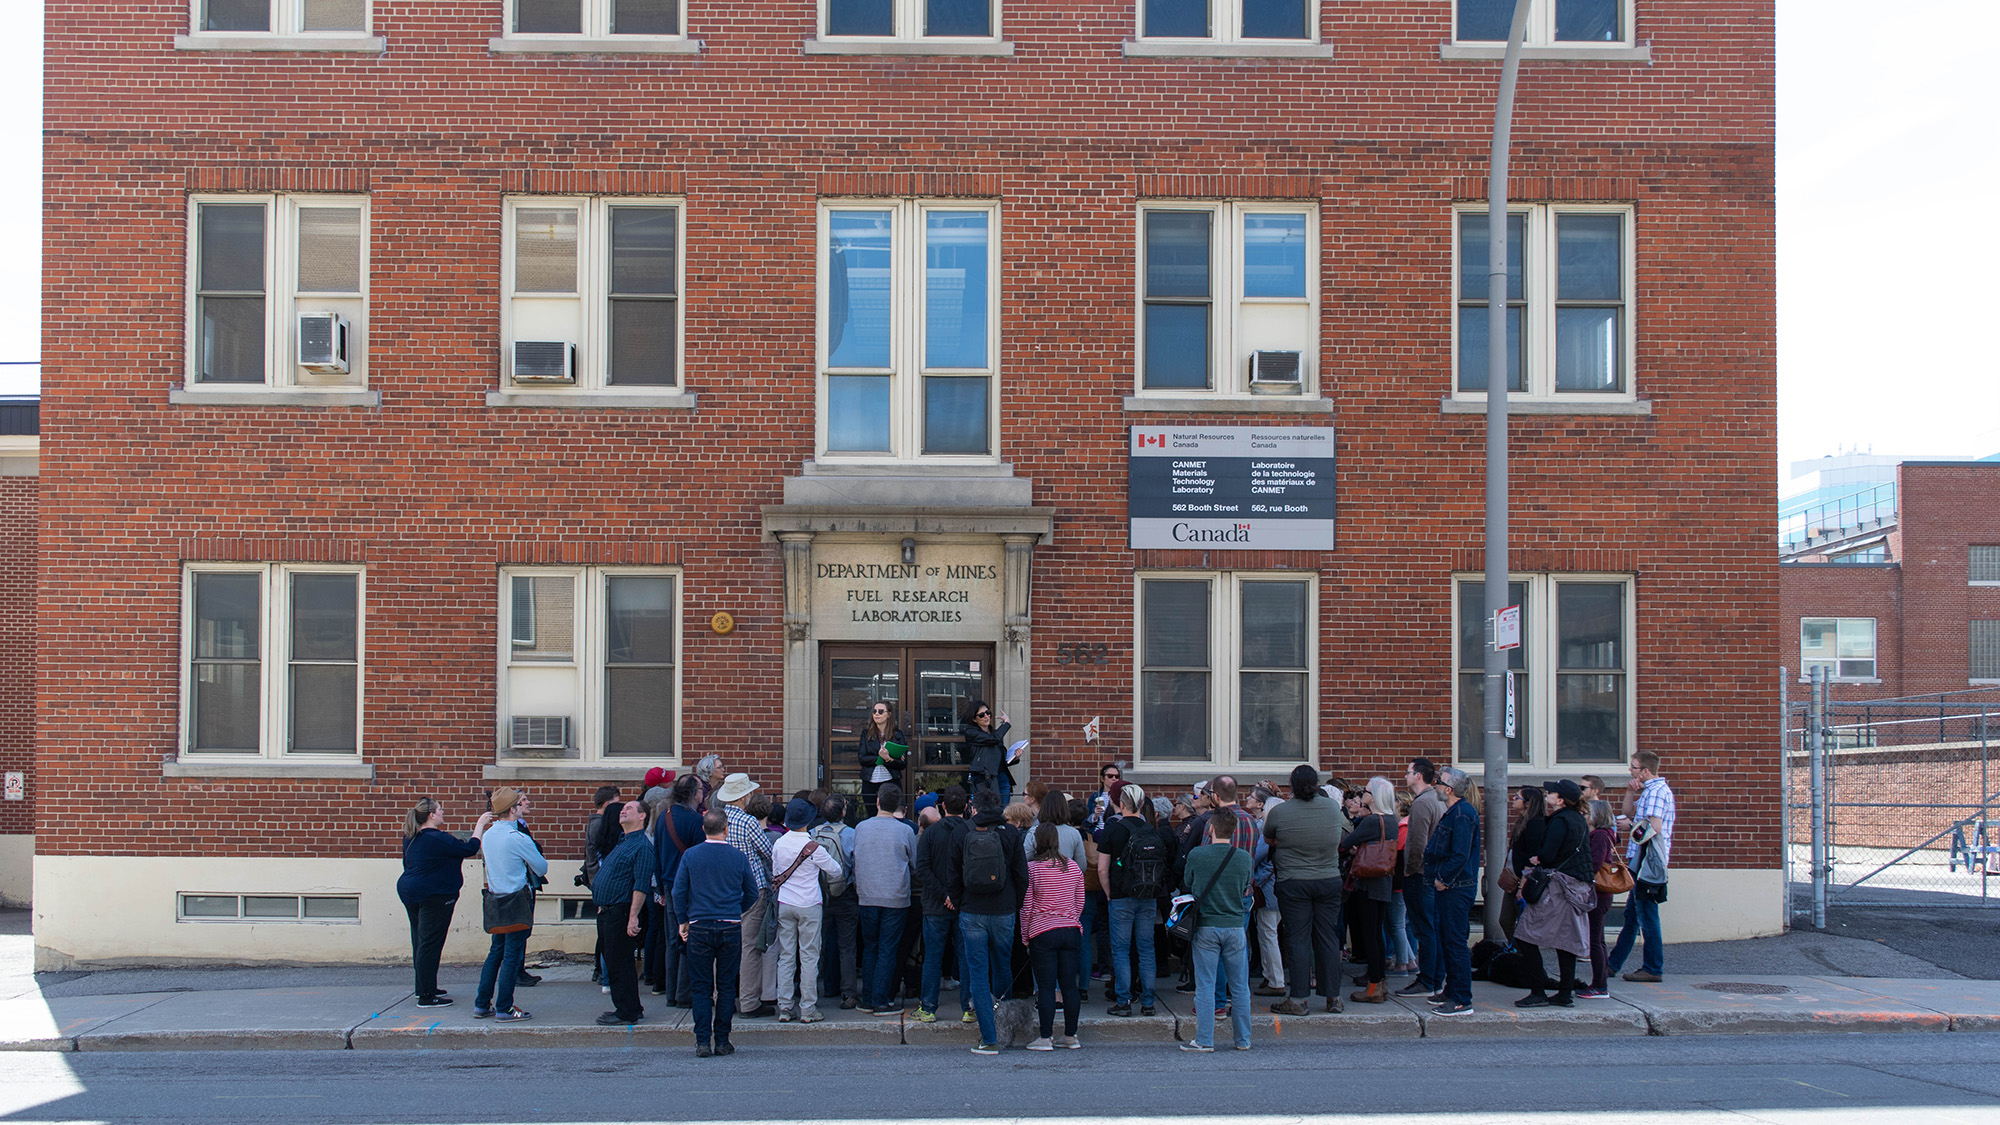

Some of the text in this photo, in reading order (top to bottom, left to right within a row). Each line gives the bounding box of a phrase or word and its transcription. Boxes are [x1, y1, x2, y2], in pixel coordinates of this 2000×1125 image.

[1271, 470, 1315, 479] technologie
[1172, 478, 1215, 486] Technology
[1172, 523, 1250, 542] Canada
[817, 564, 997, 580] DEPARTMENT OF MINES
[847, 590, 969, 602] FUEL RESEARCH
[852, 610, 962, 622] LABORATORIES
[1057, 643, 1109, 665] 562
